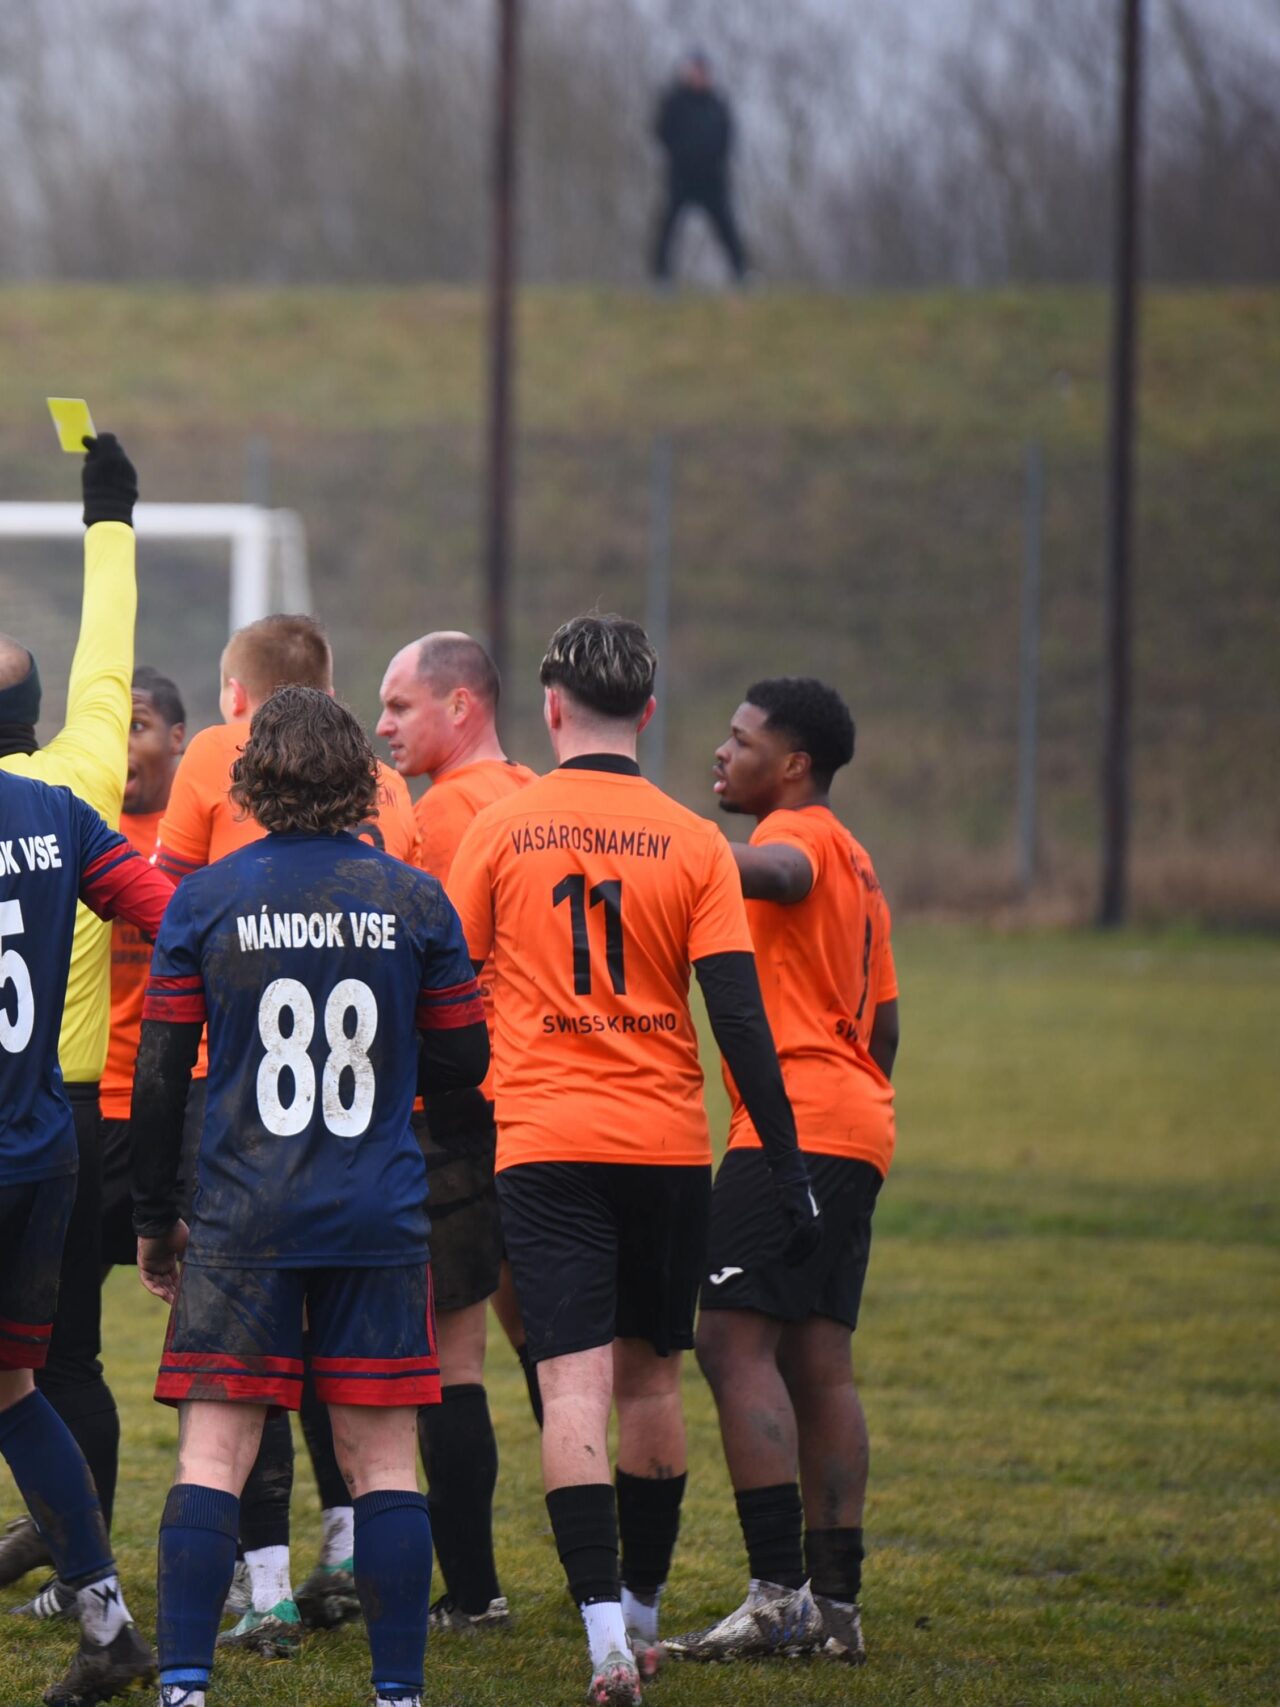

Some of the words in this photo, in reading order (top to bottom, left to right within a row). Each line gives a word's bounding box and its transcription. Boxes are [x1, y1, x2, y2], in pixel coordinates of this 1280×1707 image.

[19, 833, 63, 872] VSE
[511, 819, 671, 860] VÁSÁROSNAMÉNY
[237, 905, 345, 952] MÁNDOK
[349, 911, 397, 950] VSE
[552, 874, 627, 996] 11
[256, 977, 379, 1138] 88
